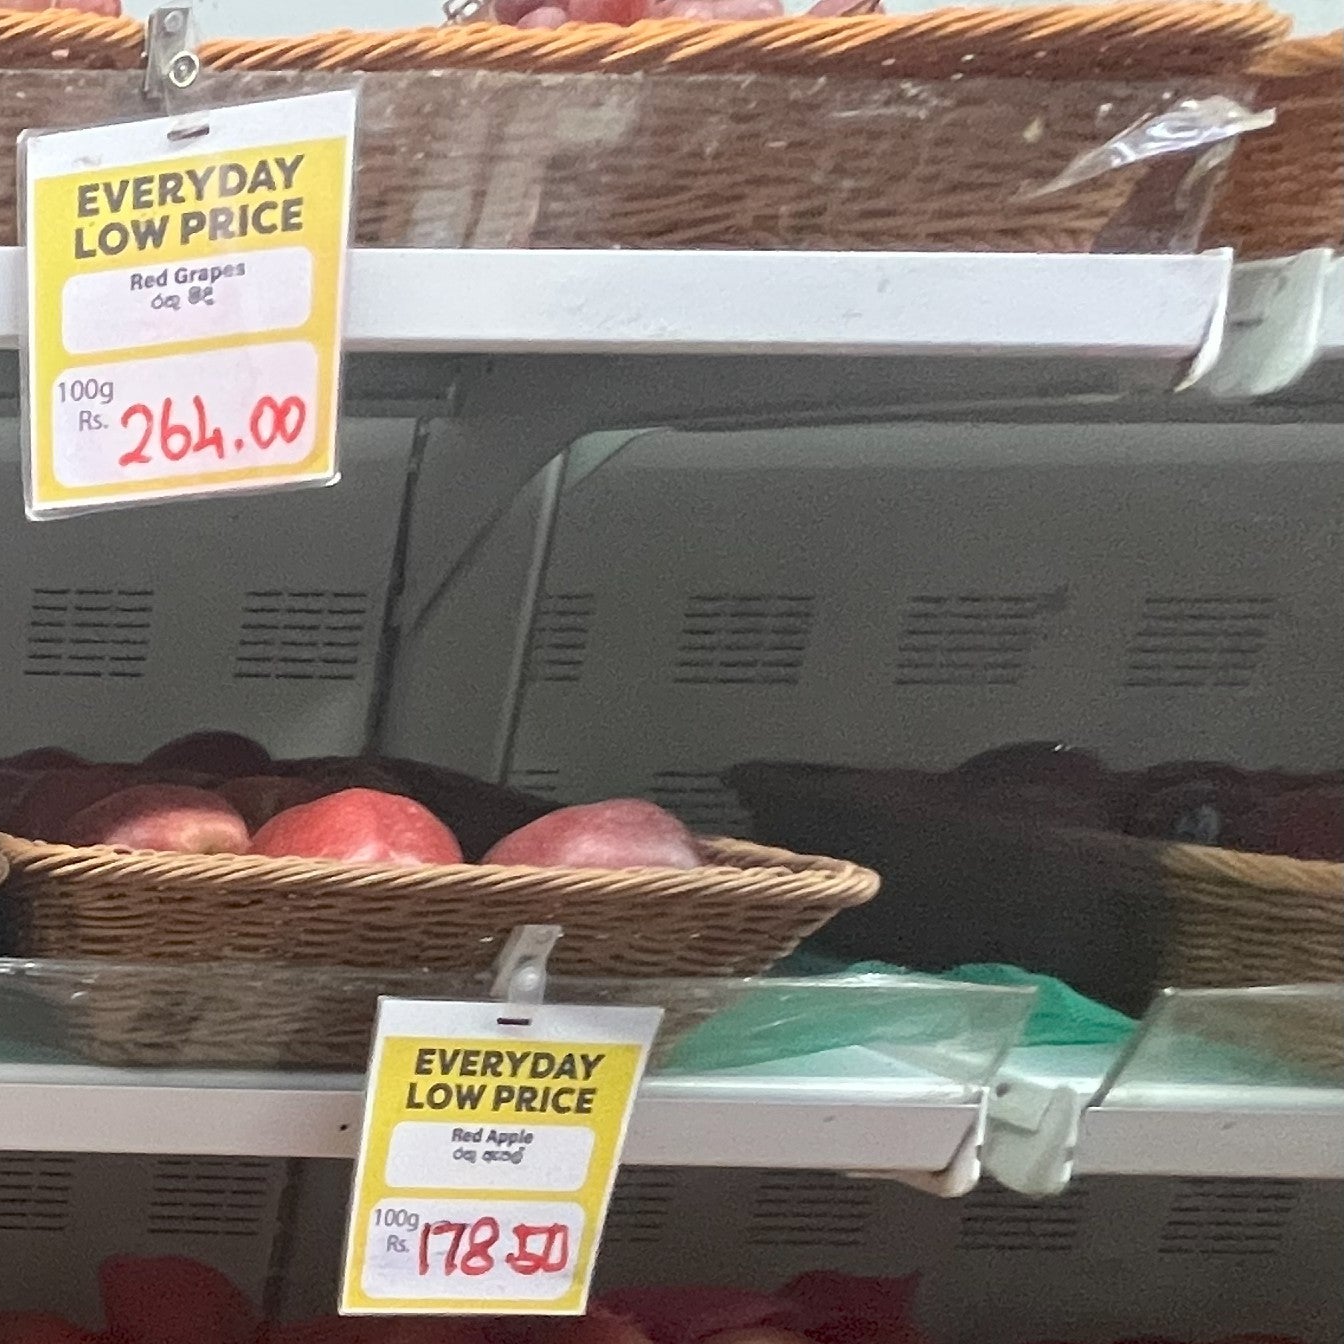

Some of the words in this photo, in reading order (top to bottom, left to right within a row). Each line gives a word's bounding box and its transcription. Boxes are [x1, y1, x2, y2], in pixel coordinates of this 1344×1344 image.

[77, 153, 306, 218] EVERYDAY
[75, 213, 170, 260] LOW
[180, 197, 304, 246] PRICE
[129, 267, 168, 292] Red
[174, 261, 246, 287] Grapes
[57, 378, 114, 404] 100g
[78, 410, 108, 432] Rs.
[119, 394, 307, 467] 264.00
[414, 1048, 606, 1081] EVERYDAY
[406, 1082, 487, 1110] LOW
[491, 1085, 598, 1115] PRICE
[452, 1128, 482, 1142] Red
[486, 1129, 534, 1147] Apple
[374, 1208, 420, 1232] 100g
[386, 1235, 409, 1254] Rs.
